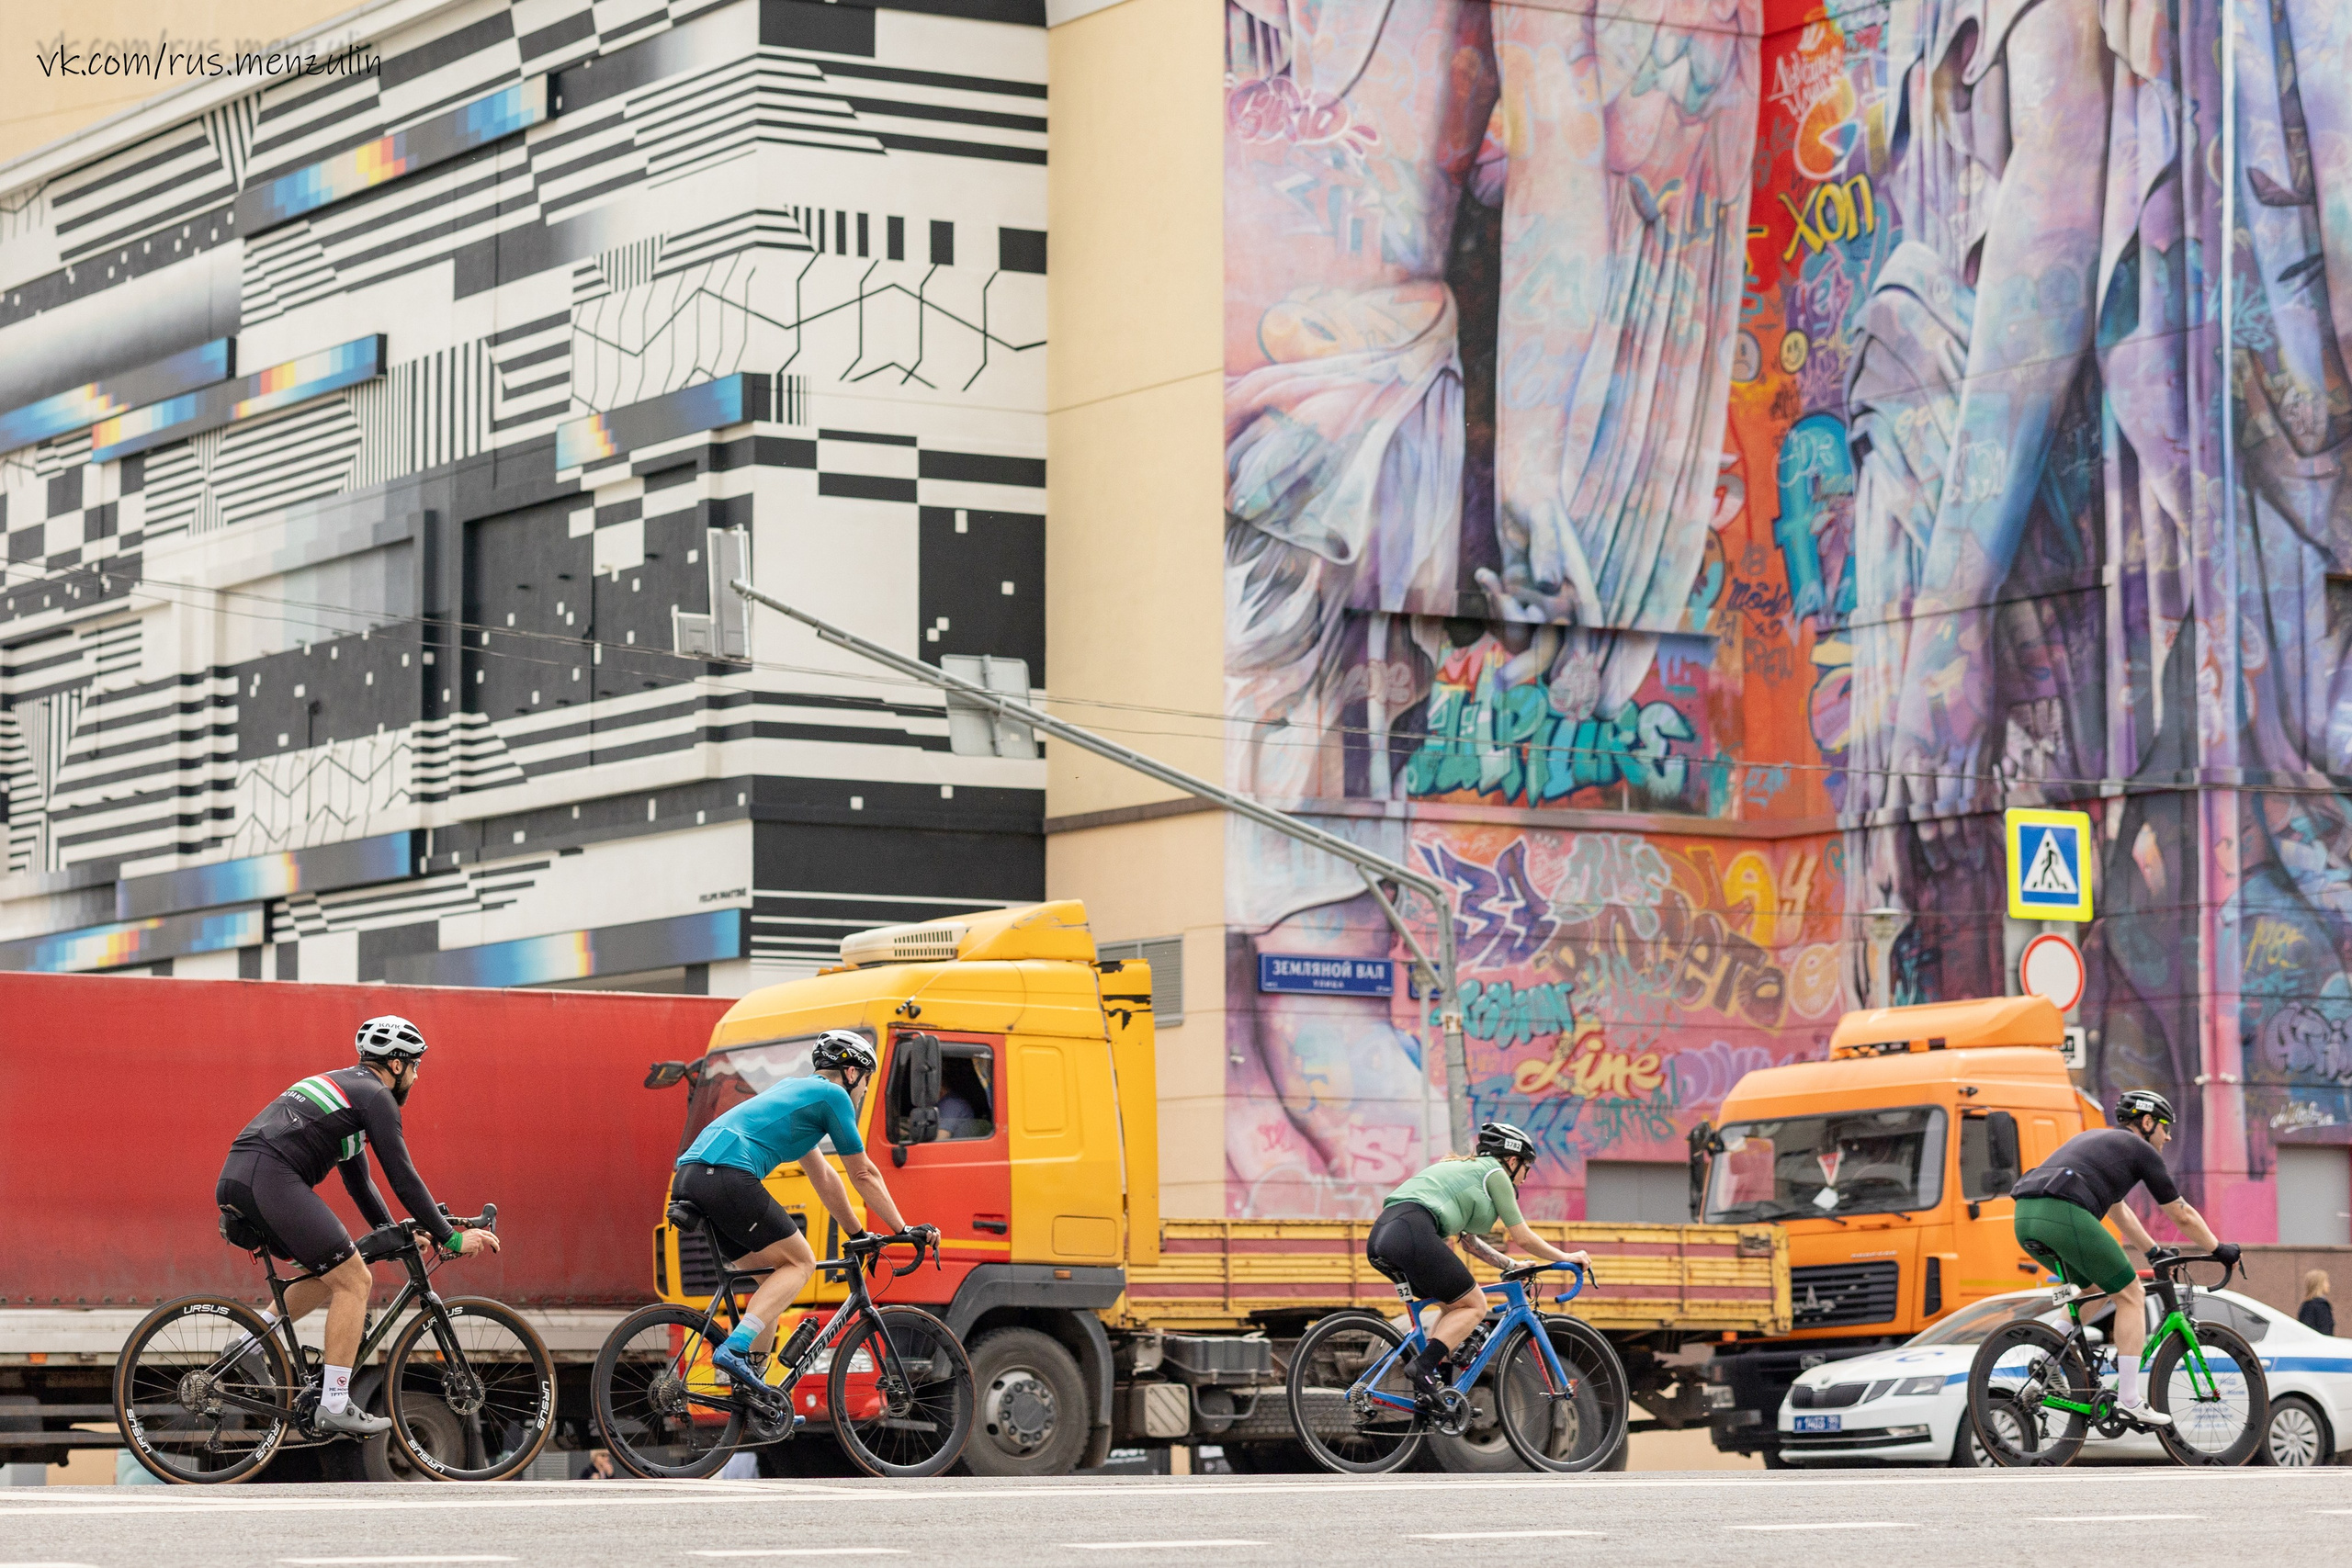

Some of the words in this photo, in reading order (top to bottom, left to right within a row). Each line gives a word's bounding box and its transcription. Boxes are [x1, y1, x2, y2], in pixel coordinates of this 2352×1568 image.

[1272, 959, 1352, 979] ЗЕМЛЯНОЙ
[1355, 963, 1385, 980] ВАЛ
[1506, 1140, 1521, 1149] 3782
[184, 1304, 230, 1315] URSUS
[423, 1306, 463, 1331] URUS
[537, 1381, 549, 1431] URSUS
[126, 1408, 152, 1454] URSUS
[407, 1438, 446, 1473] URSUS
